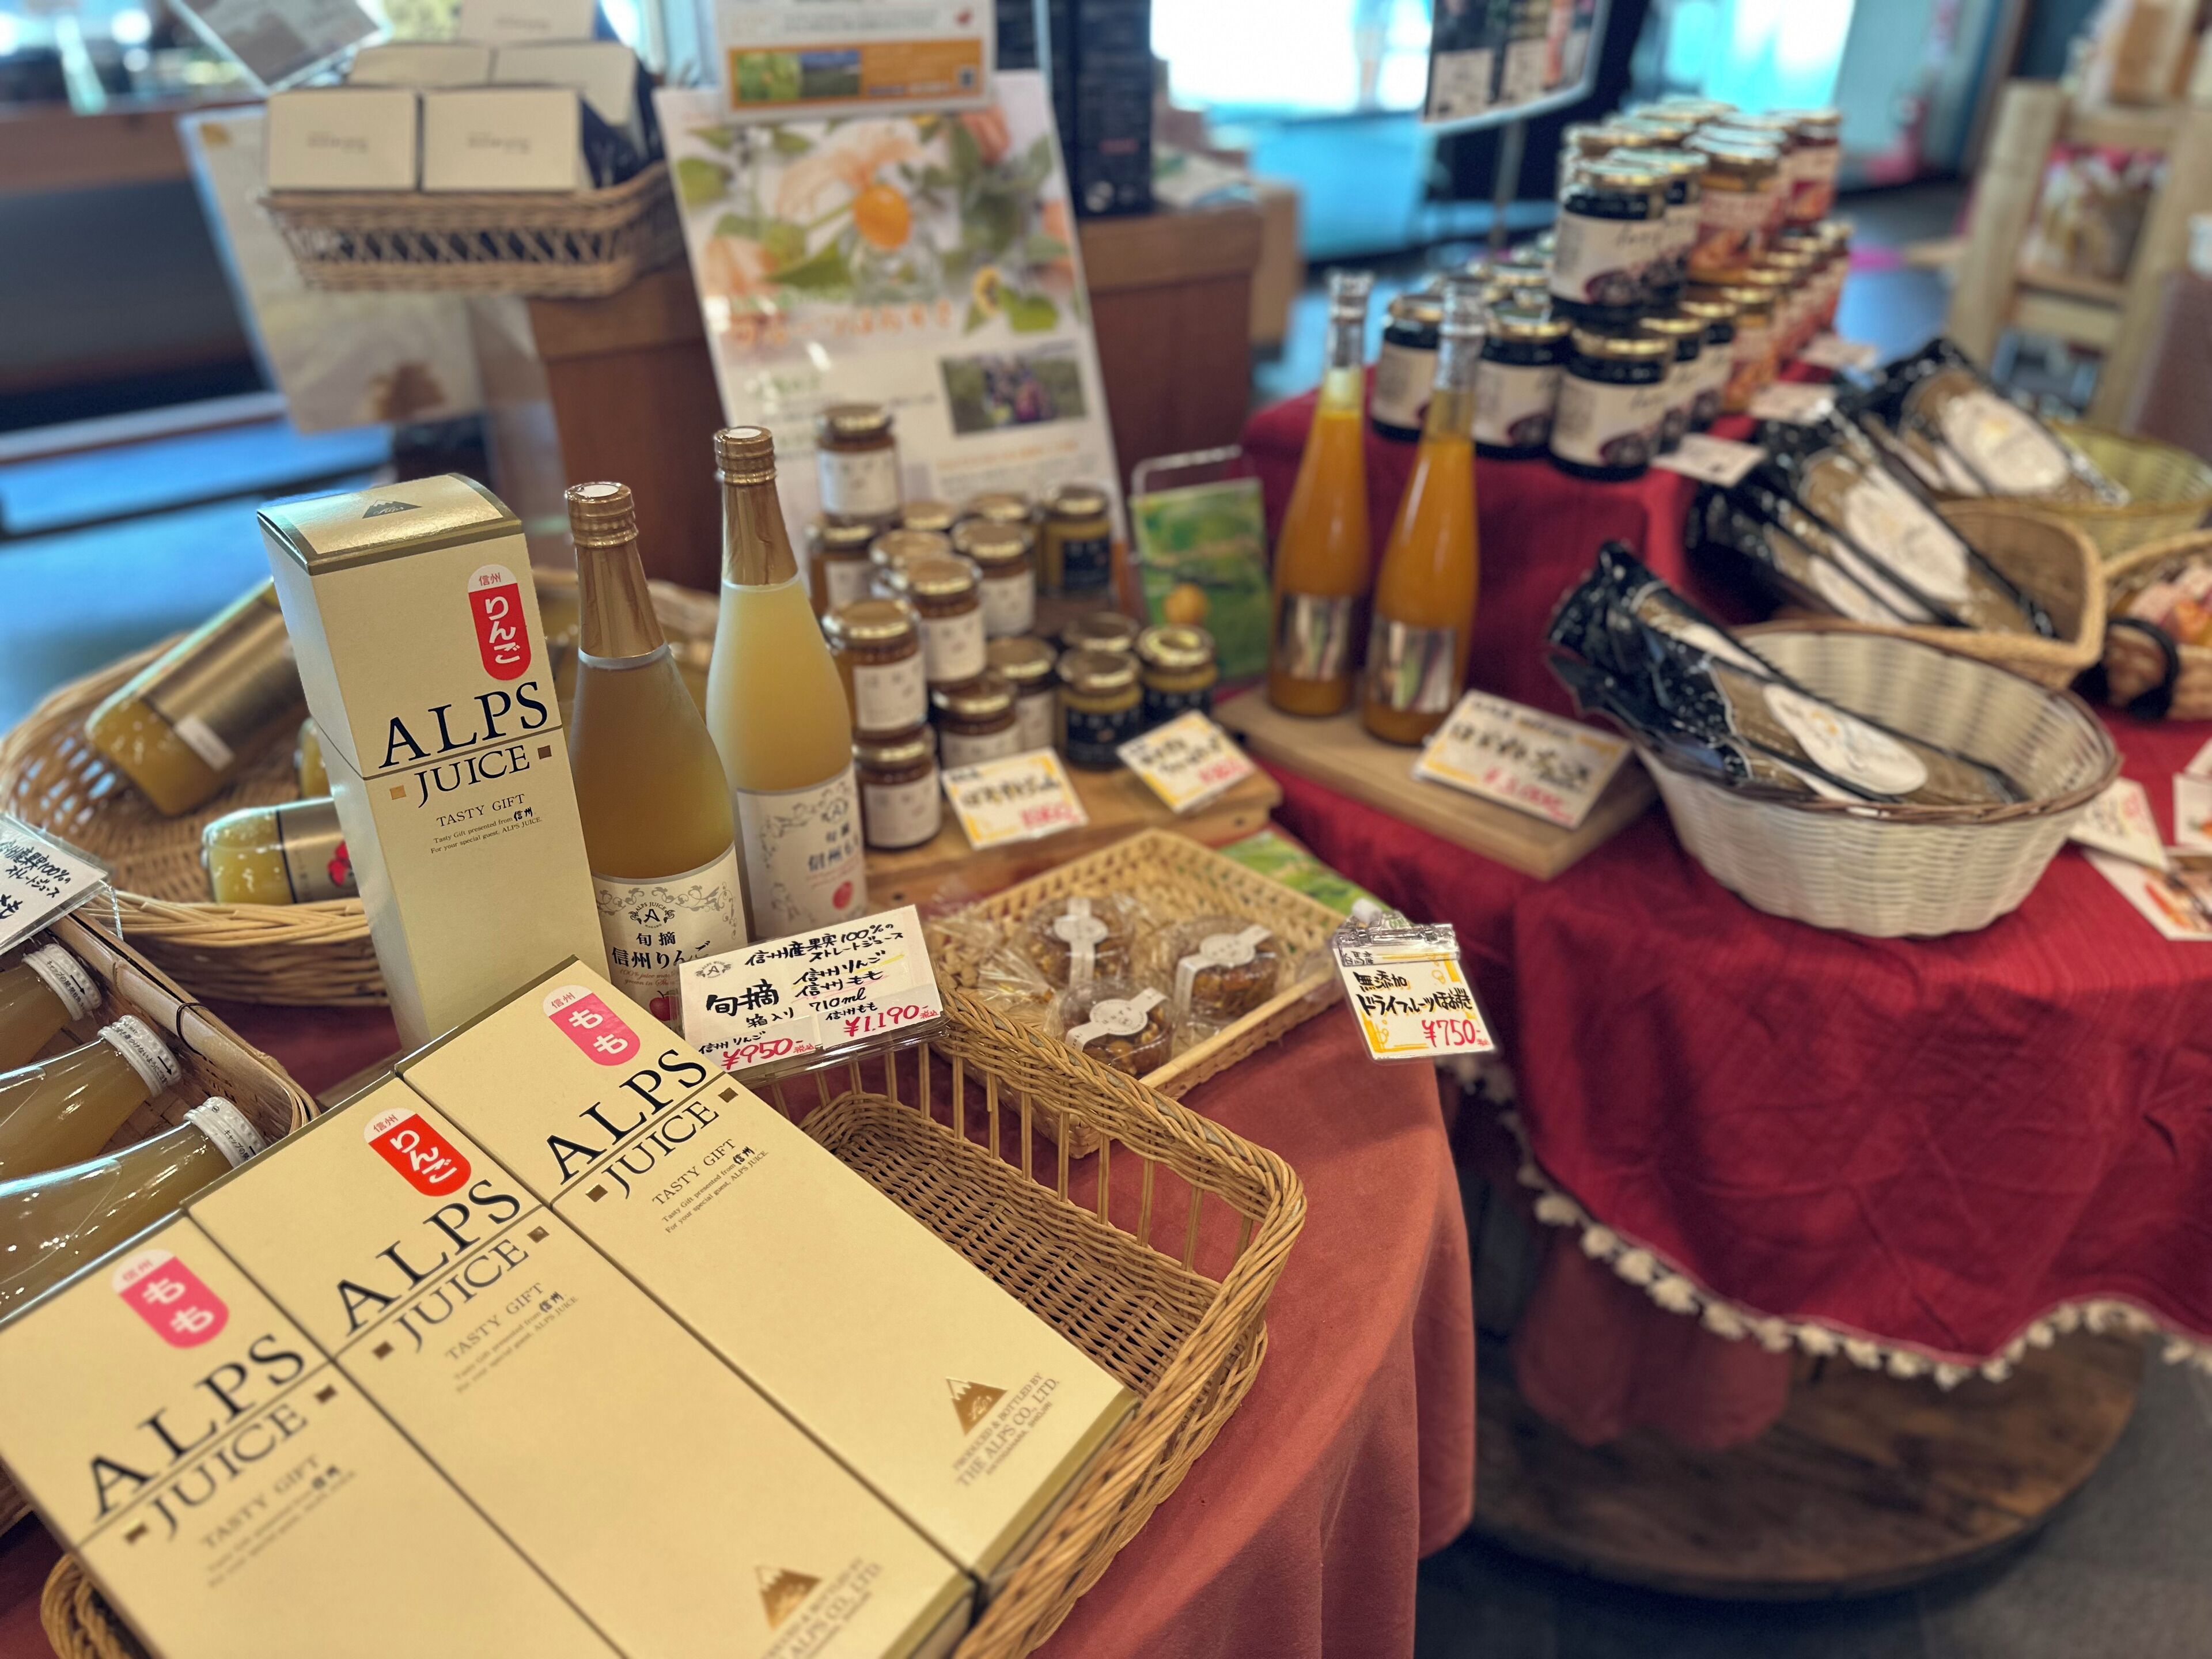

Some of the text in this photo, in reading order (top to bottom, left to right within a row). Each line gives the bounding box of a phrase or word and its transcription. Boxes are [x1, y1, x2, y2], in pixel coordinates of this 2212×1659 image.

[479, 572, 501, 586] 信州
[485, 596, 520, 664] りんご
[378, 681, 547, 768] ALPS
[414, 745, 530, 808] JUICE
[436, 793, 525, 827] TASTY GIFT
[434, 835, 452, 844] Tasty
[468, 822, 497, 836] presented
[444, 843, 458, 851] your
[460, 836, 481, 846] special
[502, 824, 520, 833] ALPS
[637, 902, 666, 914] ALPS JUICE
[612, 941, 710, 969] 信州りんご
[636, 931, 676, 946] 旬摘
[745, 923, 893, 965] 信州産果実100%の
[809, 933, 903, 963] ストレートジュース
[793, 950, 885, 985] 信州りんご
[795, 971, 883, 997] 信州もも
[1353, 970, 1407, 992] 無添加
[551, 992, 576, 1009] 信州
[706, 979, 779, 1017] 旬摘
[746, 1007, 794, 1028] 箱入り
[809, 987, 866, 1012] 710ml
[825, 1002, 878, 1020] 信州もも
[1356, 987, 1473, 1016] ドライフルーツほおずき
[569, 1009, 628, 1054] もも
[698, 1031, 766, 1055] 信州りんご
[373, 1113, 399, 1132] 信州
[547, 1049, 706, 1185] ALPS
[389, 1130, 457, 1183] りんご
[601, 1101, 719, 1199] JUICE
[652, 1139, 736, 1205] TASTY GIFT
[662, 1207, 681, 1222] Tasty
[680, 1197, 694, 1208] Gift
[694, 1174, 722, 1198] presented
[721, 1164, 736, 1176] from
[665, 1222, 678, 1233] For
[679, 1211, 692, 1224] your
[693, 1194, 714, 1212] special
[730, 1165, 748, 1181] ALPS
[337, 1179, 520, 1337] ALPS
[142, 1278, 214, 1334] もも
[393, 1239, 529, 1354] JUICE
[446, 1282, 543, 1360] TASTY GIFT
[535, 1313, 555, 1331] ALPS
[998, 1384, 1032, 1422] BOTTLED
[1029, 1372, 1043, 1387] BY
[90, 1334, 304, 1524] ALPS
[984, 1425, 1016, 1459] ALPS
[1032, 1378, 1060, 1404] LTD.
[150, 1403, 309, 1543] JUICE
[200, 1493, 267, 1548] TASTY
